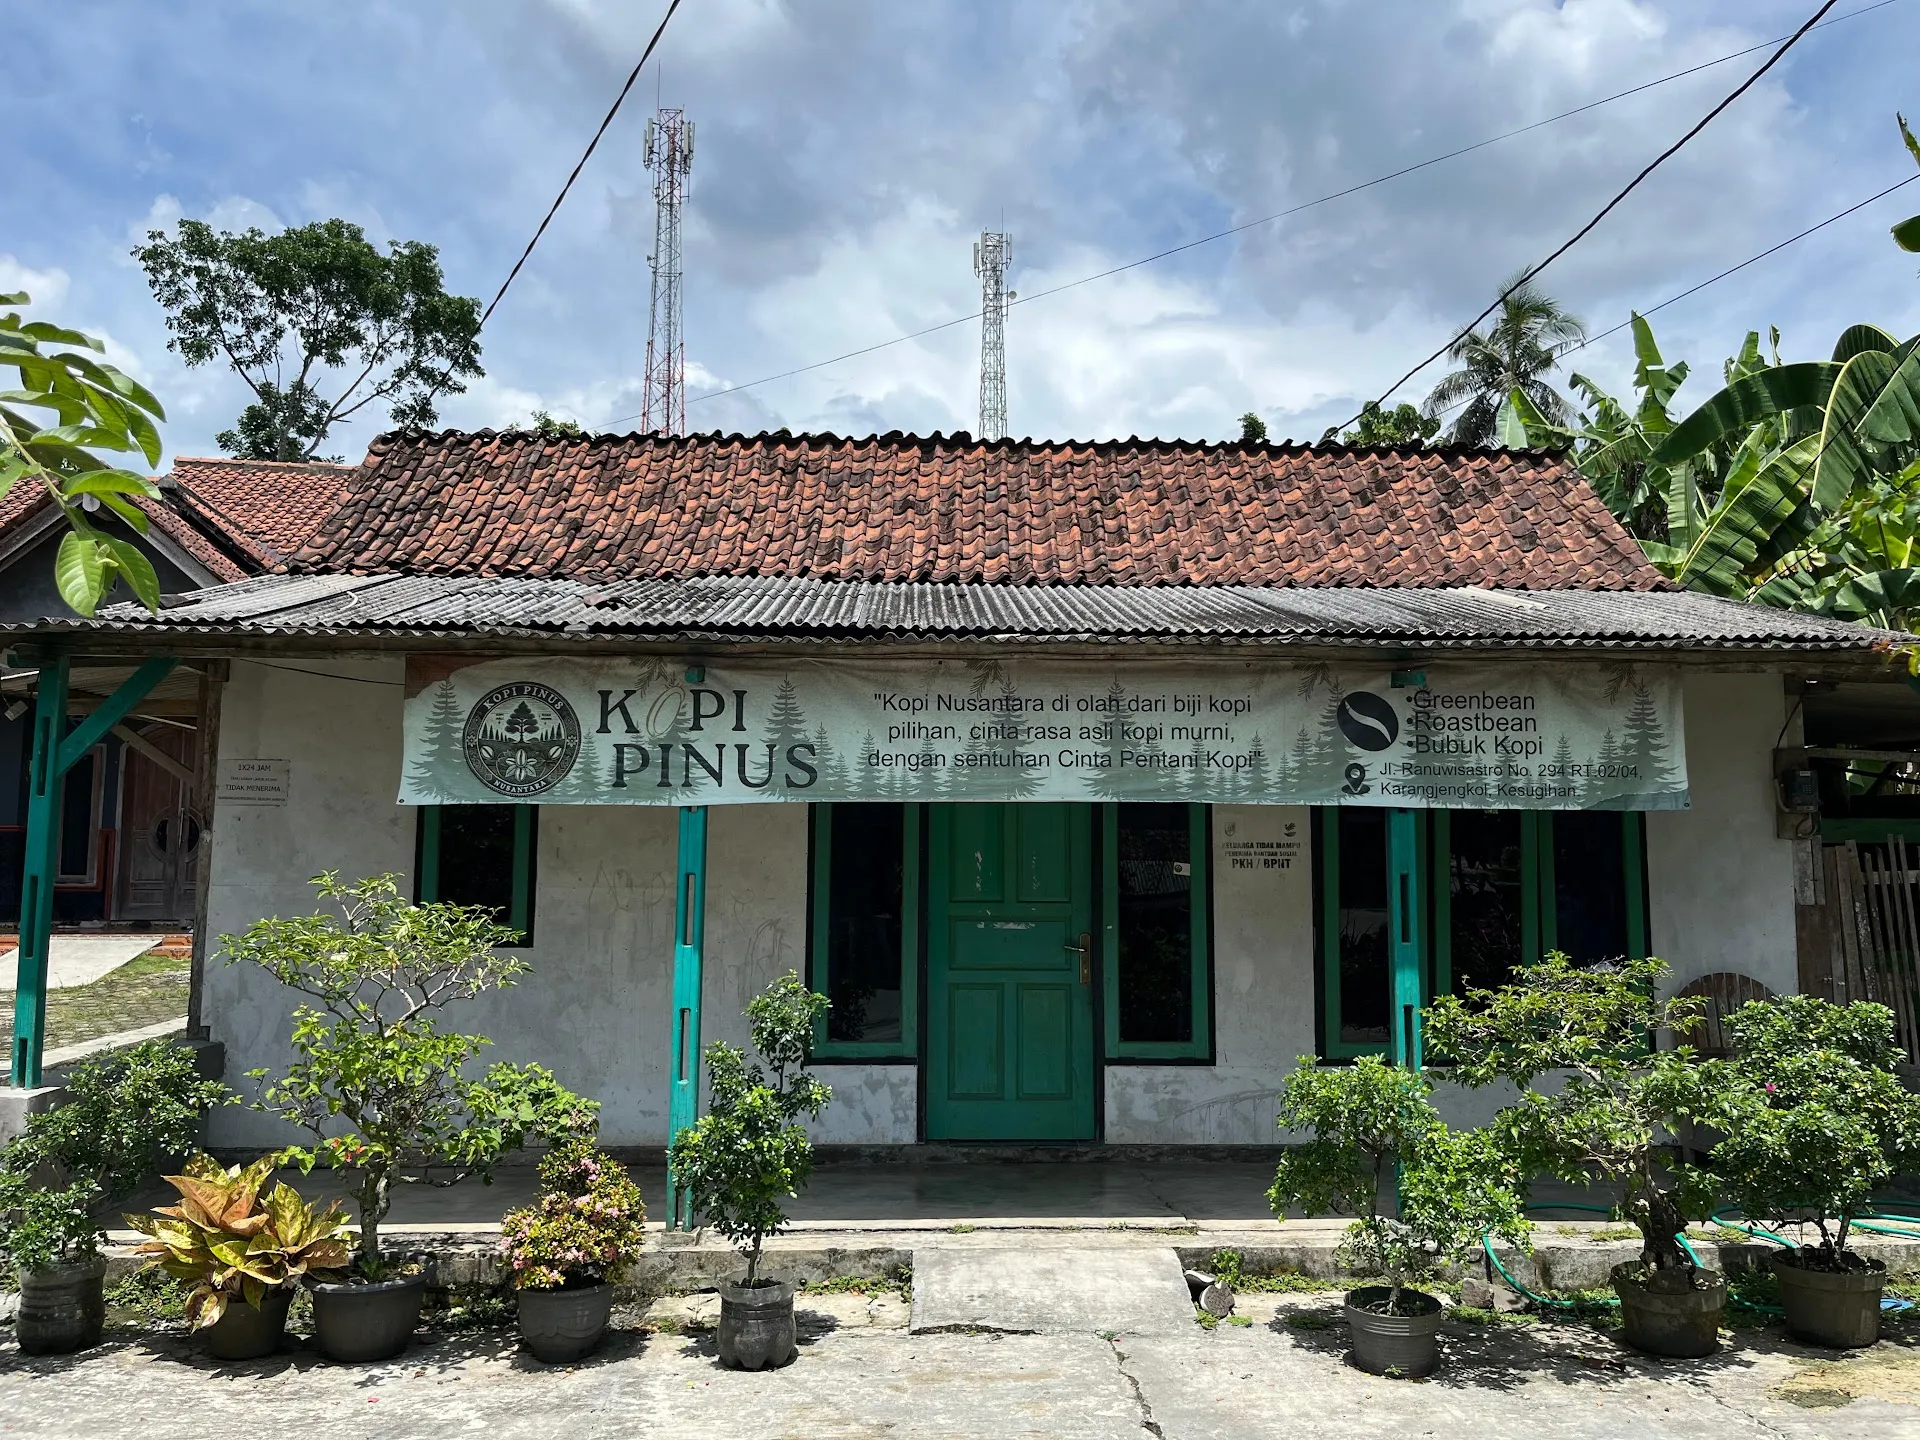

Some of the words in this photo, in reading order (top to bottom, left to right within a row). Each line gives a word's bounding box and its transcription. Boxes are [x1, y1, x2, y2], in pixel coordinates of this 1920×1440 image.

[483, 687, 518, 710] KOPI
[523, 686, 564, 710] PINUS
[874, 693, 929, 716] "Kopi
[936, 694, 1044, 712] Nusantara
[1052, 693, 1070, 712] di
[1077, 694, 1120, 712] olah
[1128, 694, 1166, 712] dari
[1174, 694, 1201, 716] biji
[1210, 694, 1252, 716] kopi
[1414, 690, 1535, 710] Greenbean
[1415, 712, 1536, 732] Roastbean
[888, 722, 962, 744] pilihan,
[970, 722, 1018, 740] cinta
[1026, 727, 1072, 741] rasa
[1078, 722, 1113, 741] asli
[1122, 722, 1163, 744] kopi
[1171, 722, 1234, 744] murni,
[1416, 735, 1486, 754] Bubuk
[1494, 736, 1542, 760] Kopi
[612, 742, 818, 788] PINUS
[868, 750, 946, 772] dengan
[954, 750, 1050, 768] sentuhan
[1058, 750, 1112, 768] Cinta
[1120, 750, 1198, 768] Pentani
[1206, 750, 1262, 773] Kopi"
[1380, 762, 1396, 776] Jl.
[1402, 763, 1502, 776] Ranuwisastro
[1508, 764, 1532, 776] No.
[1538, 764, 1566, 776] 294
[494, 780, 547, 793] NUSANTARA
[1381, 782, 1492, 798] Karangjengkol,
[1498, 784, 1580, 800] Kesugihan.
[1232, 858, 1253, 868] PKH
[1264, 858, 1292, 868] BPNT
